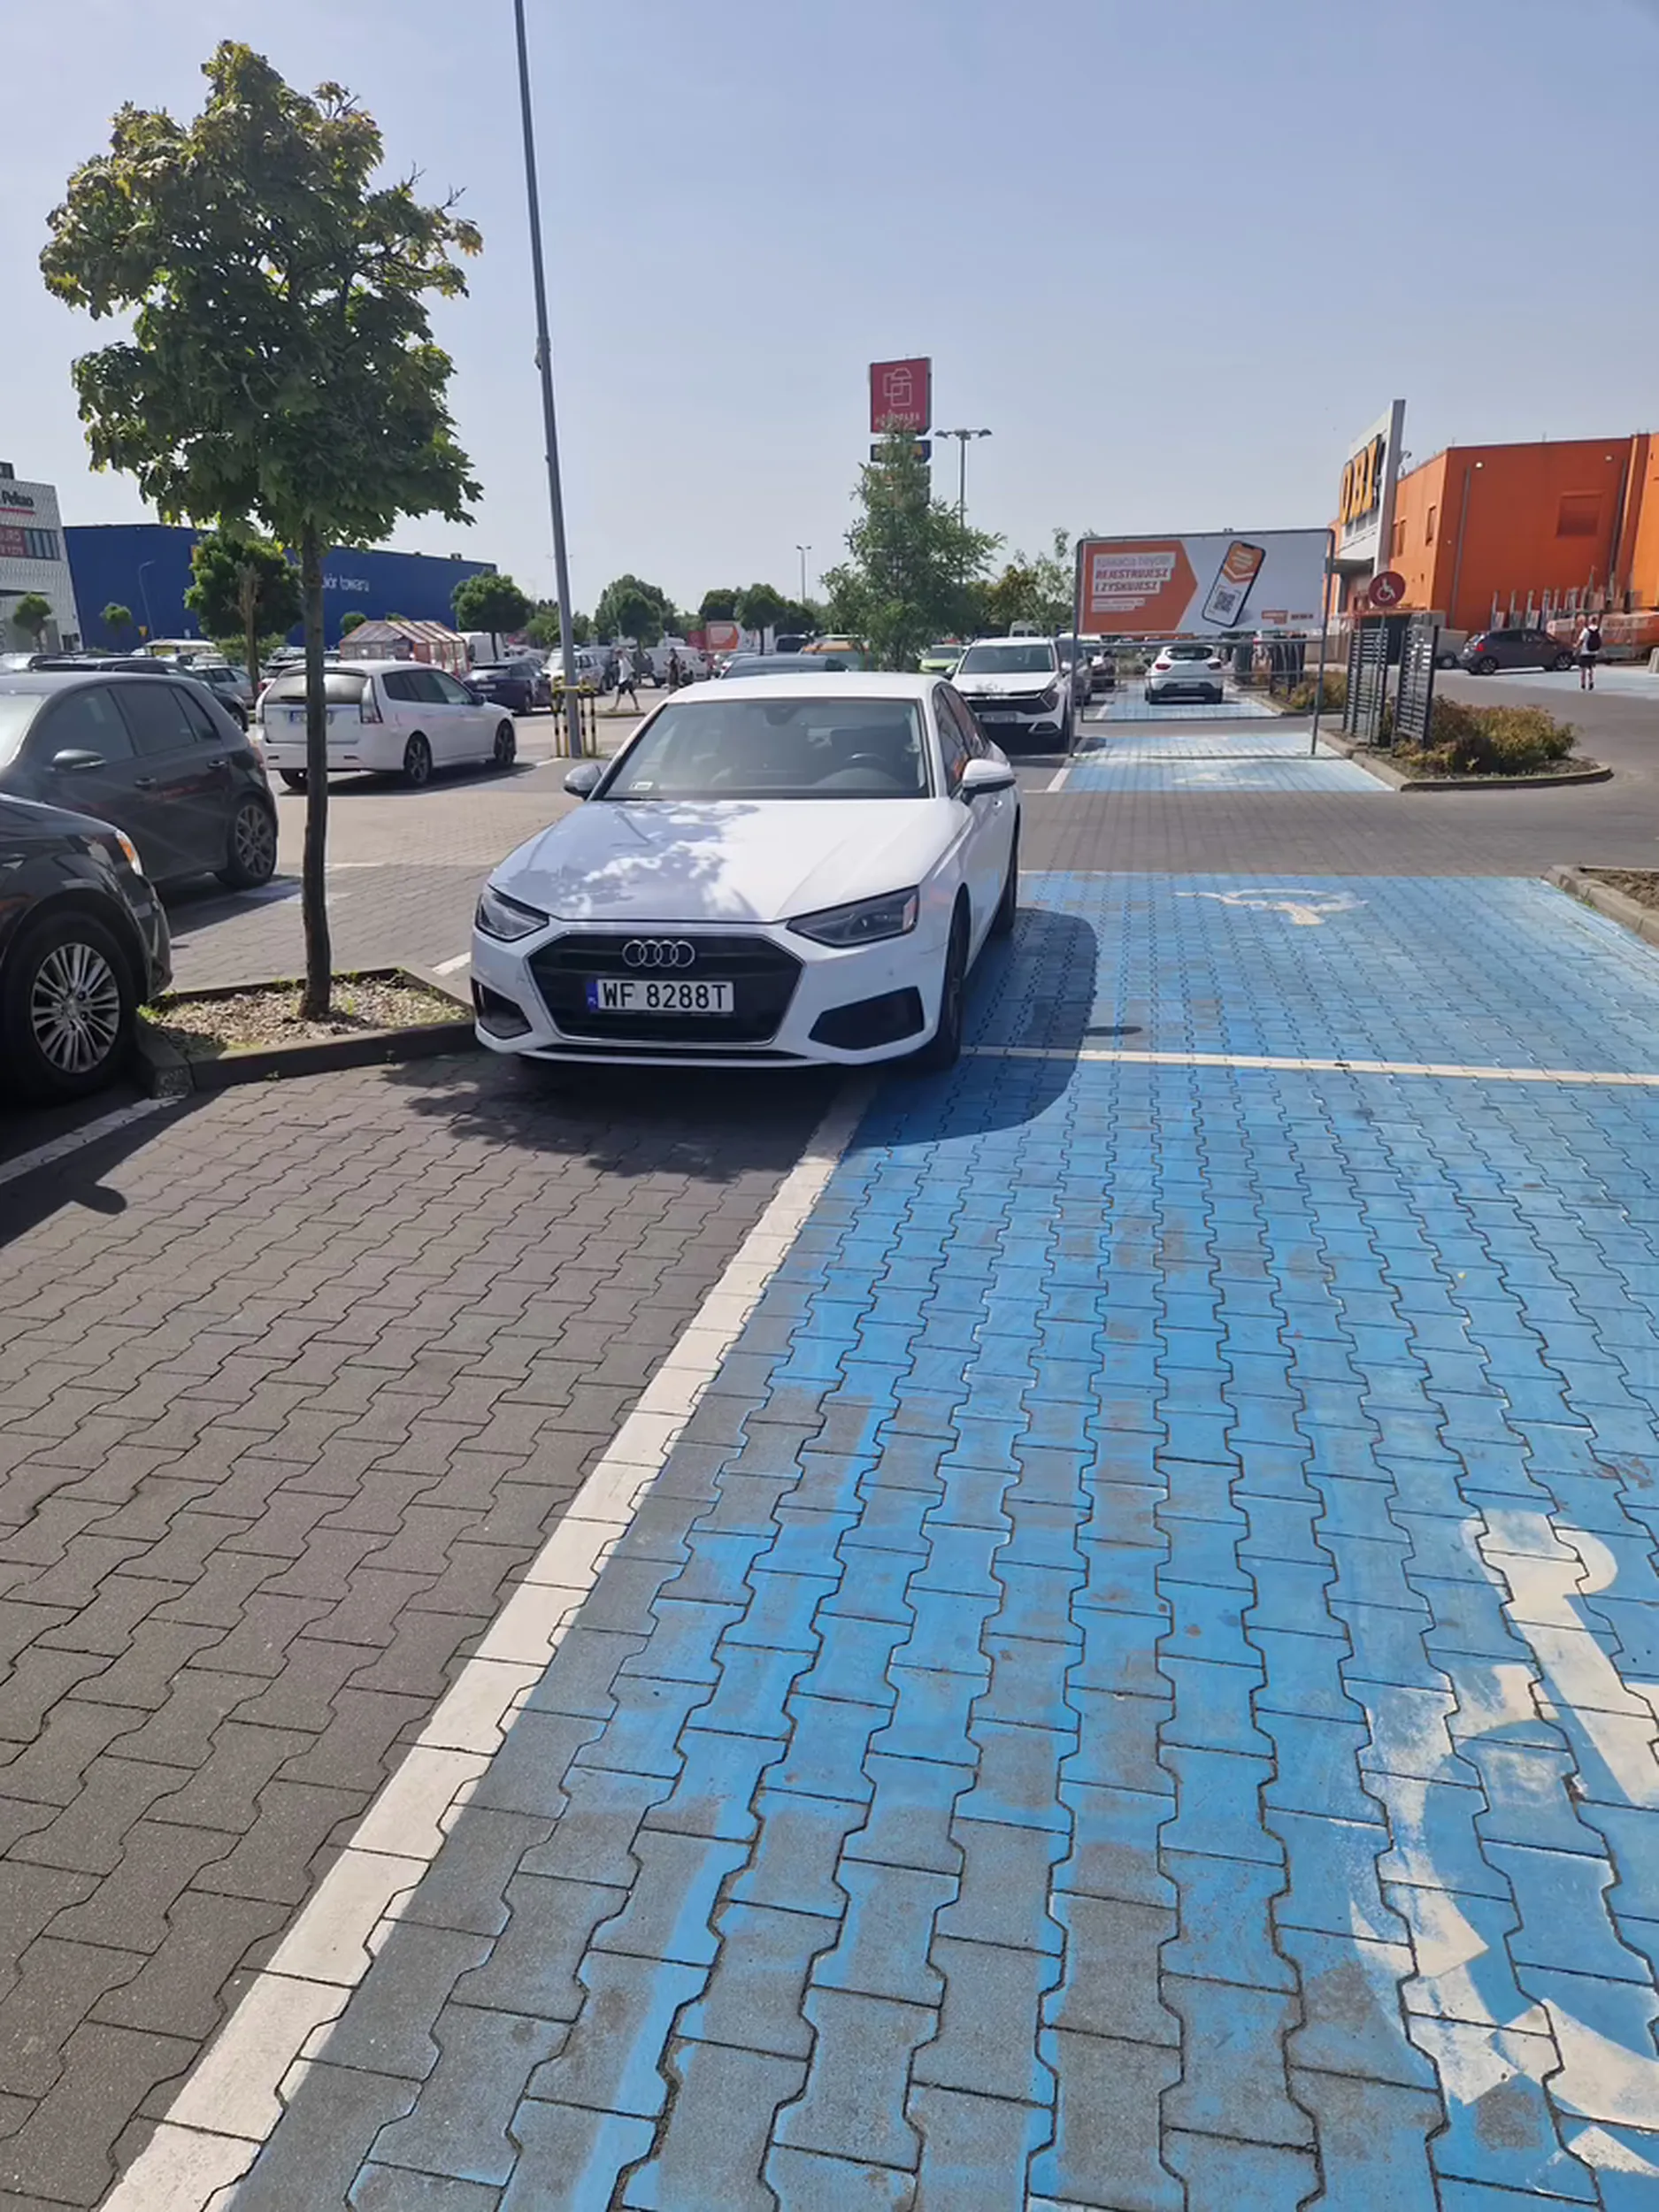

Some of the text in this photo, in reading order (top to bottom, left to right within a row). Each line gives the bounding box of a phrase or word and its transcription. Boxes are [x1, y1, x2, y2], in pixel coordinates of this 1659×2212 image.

[1340, 435, 1378, 524] OBI
[1095, 569, 1168, 580] REJESTRUJESZ
[1101, 581, 1157, 592] ZYSKUJESZ
[603, 982, 727, 1010] WF 8288T
